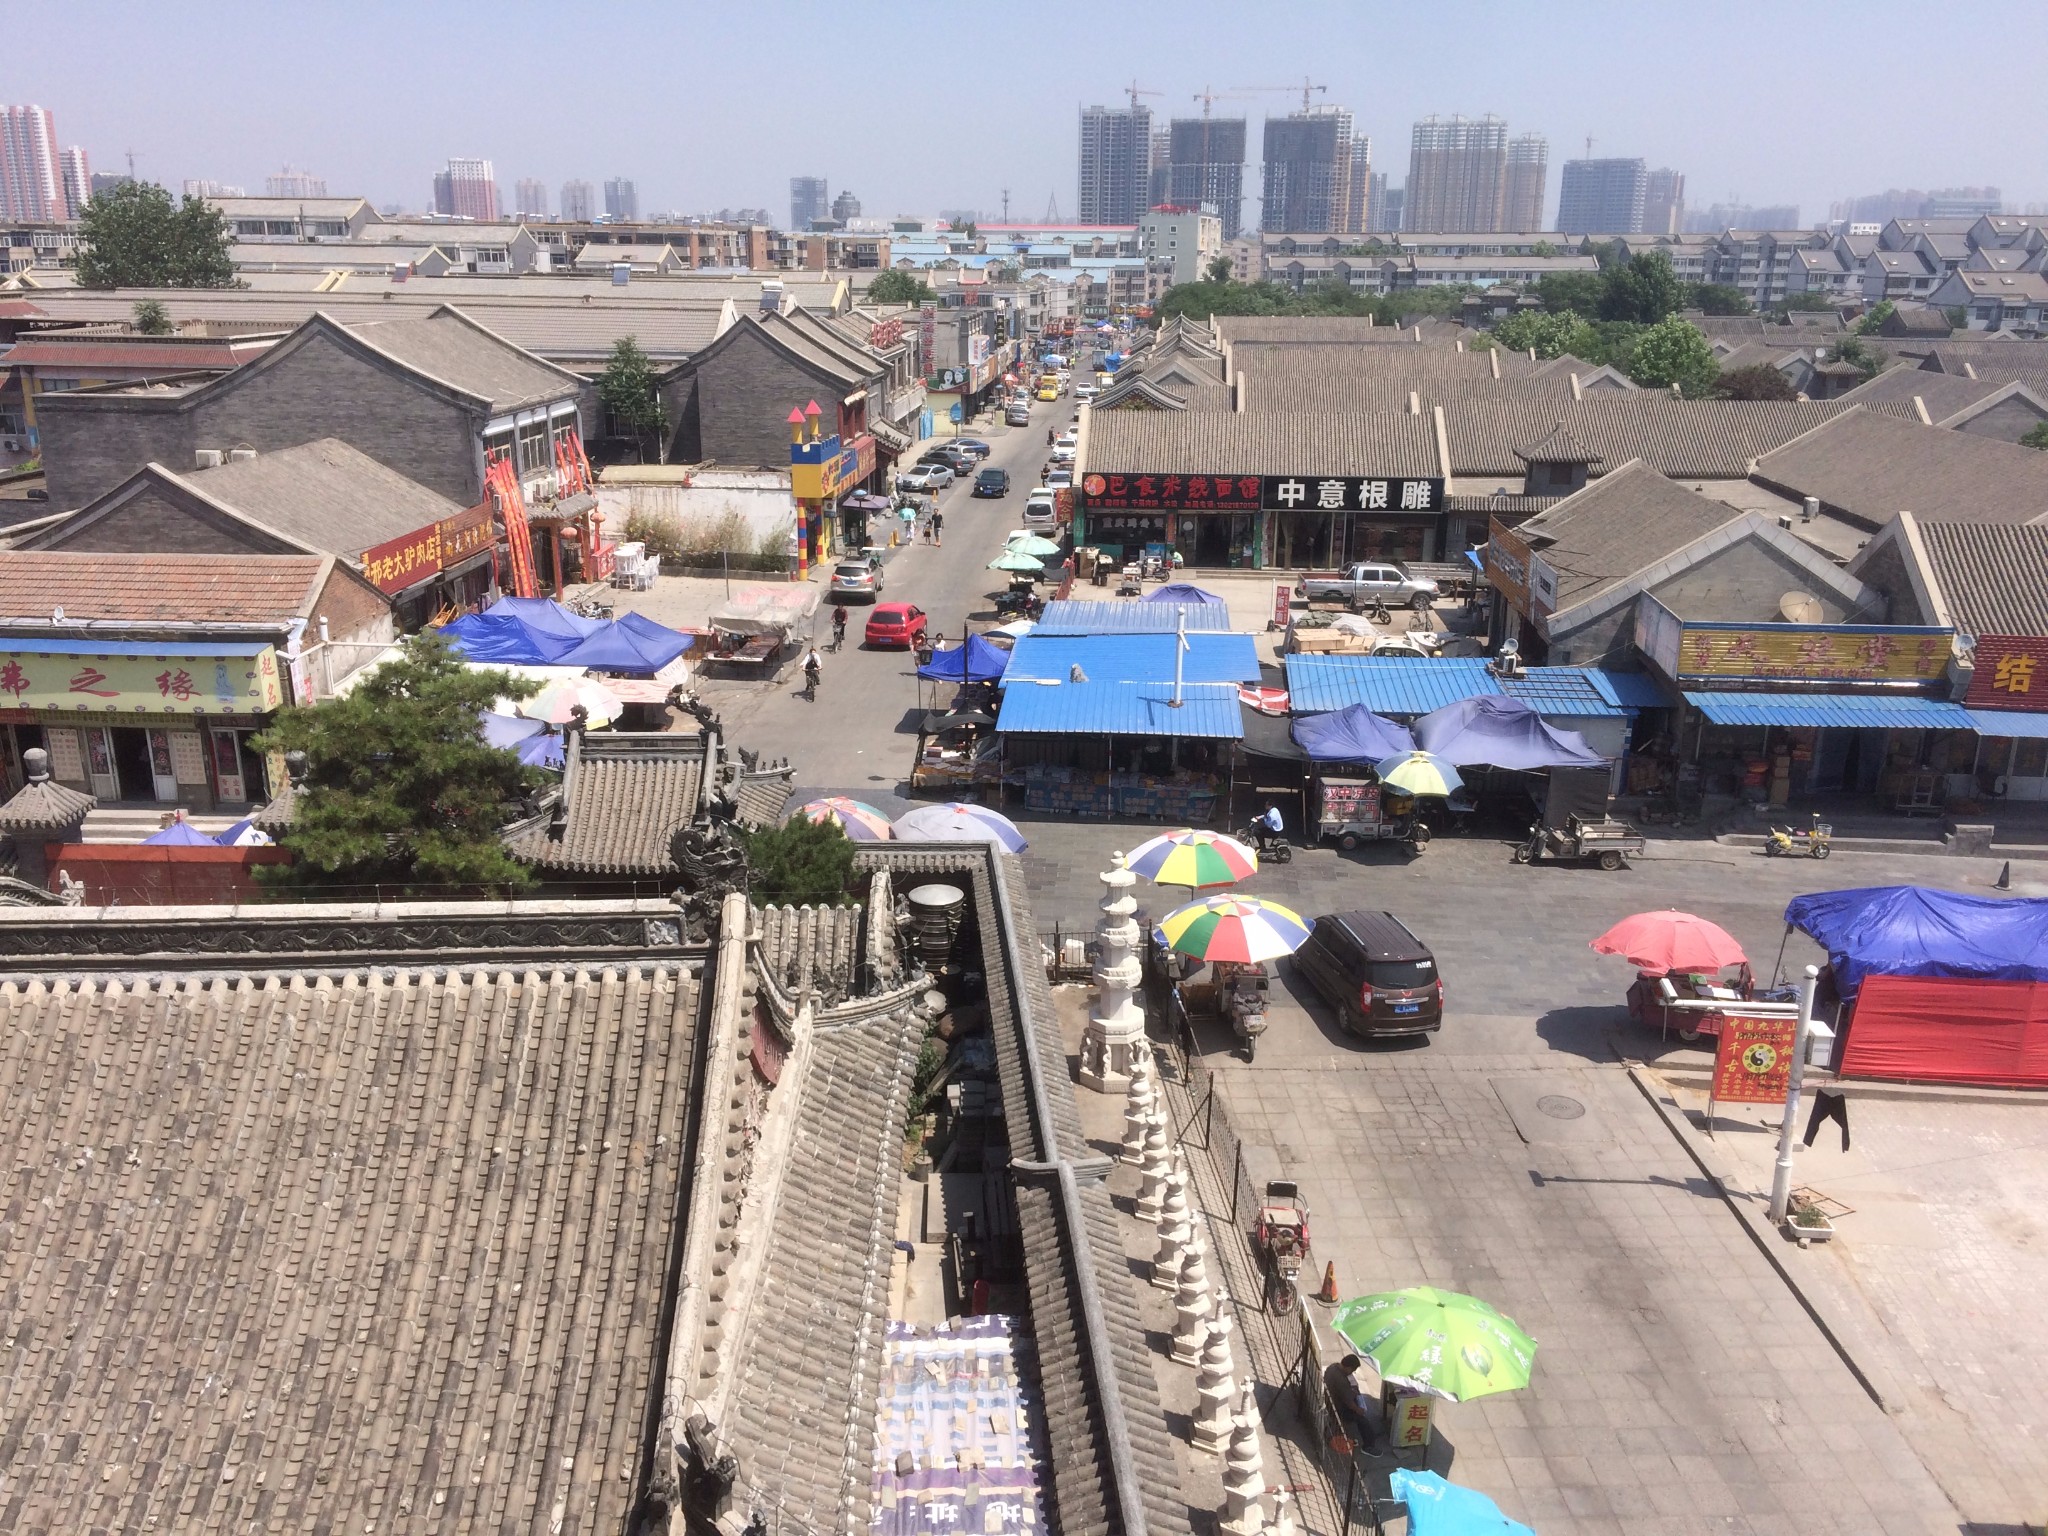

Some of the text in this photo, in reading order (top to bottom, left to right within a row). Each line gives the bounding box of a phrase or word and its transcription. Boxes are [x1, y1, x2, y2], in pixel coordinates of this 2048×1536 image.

[1277, 478, 1432, 509] 中意根雕
[1993, 653, 2040, 693] 结
[1729, 1017, 1797, 1032] 中国九华山
[1725, 1041, 1741, 1072] 千古
[1404, 1404, 1429, 1443] 起名
